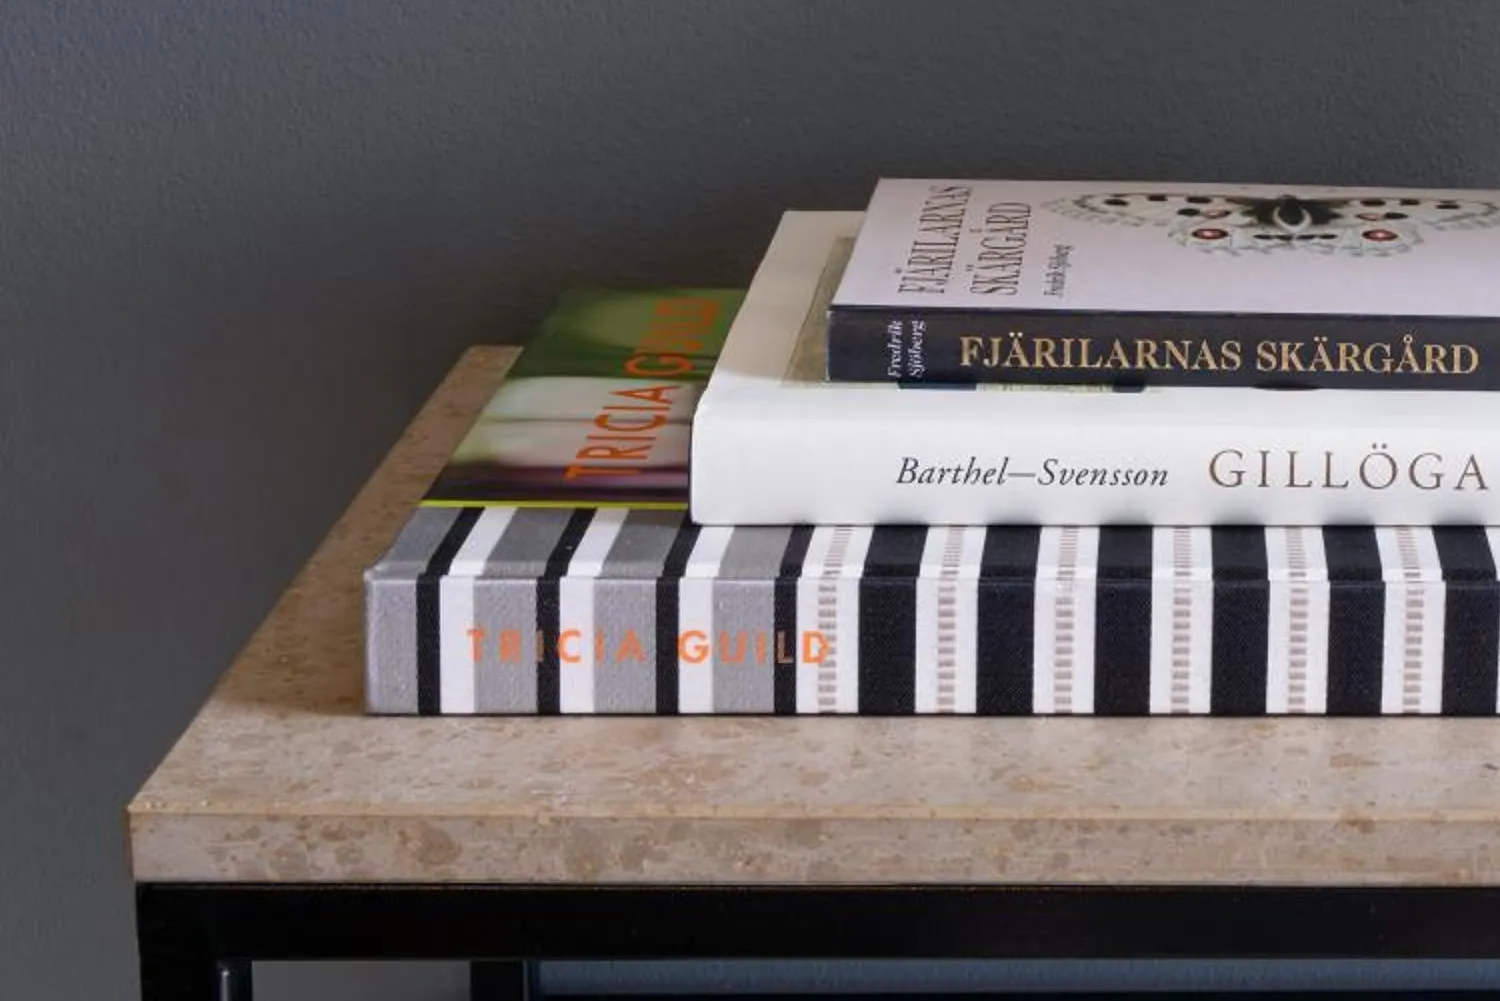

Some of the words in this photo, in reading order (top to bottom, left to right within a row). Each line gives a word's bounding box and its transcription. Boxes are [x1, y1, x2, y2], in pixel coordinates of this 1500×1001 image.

[894, 184, 973, 294] FJÄRILARNAS
[966, 201, 1032, 296] SKÄRGÅRD
[887, 320, 903, 379] Fredrik
[908, 319, 926, 379] Sjöberg
[959, 331, 1242, 372] FJÄRILARNAS
[1256, 334, 1480, 375] SKÄRGÅRD
[562, 385, 682, 482] TRICIA
[1208, 442, 1490, 491] GILLÖGA
[466, 629, 647, 664] TRICIA
[677, 629, 831, 665] GUILD
